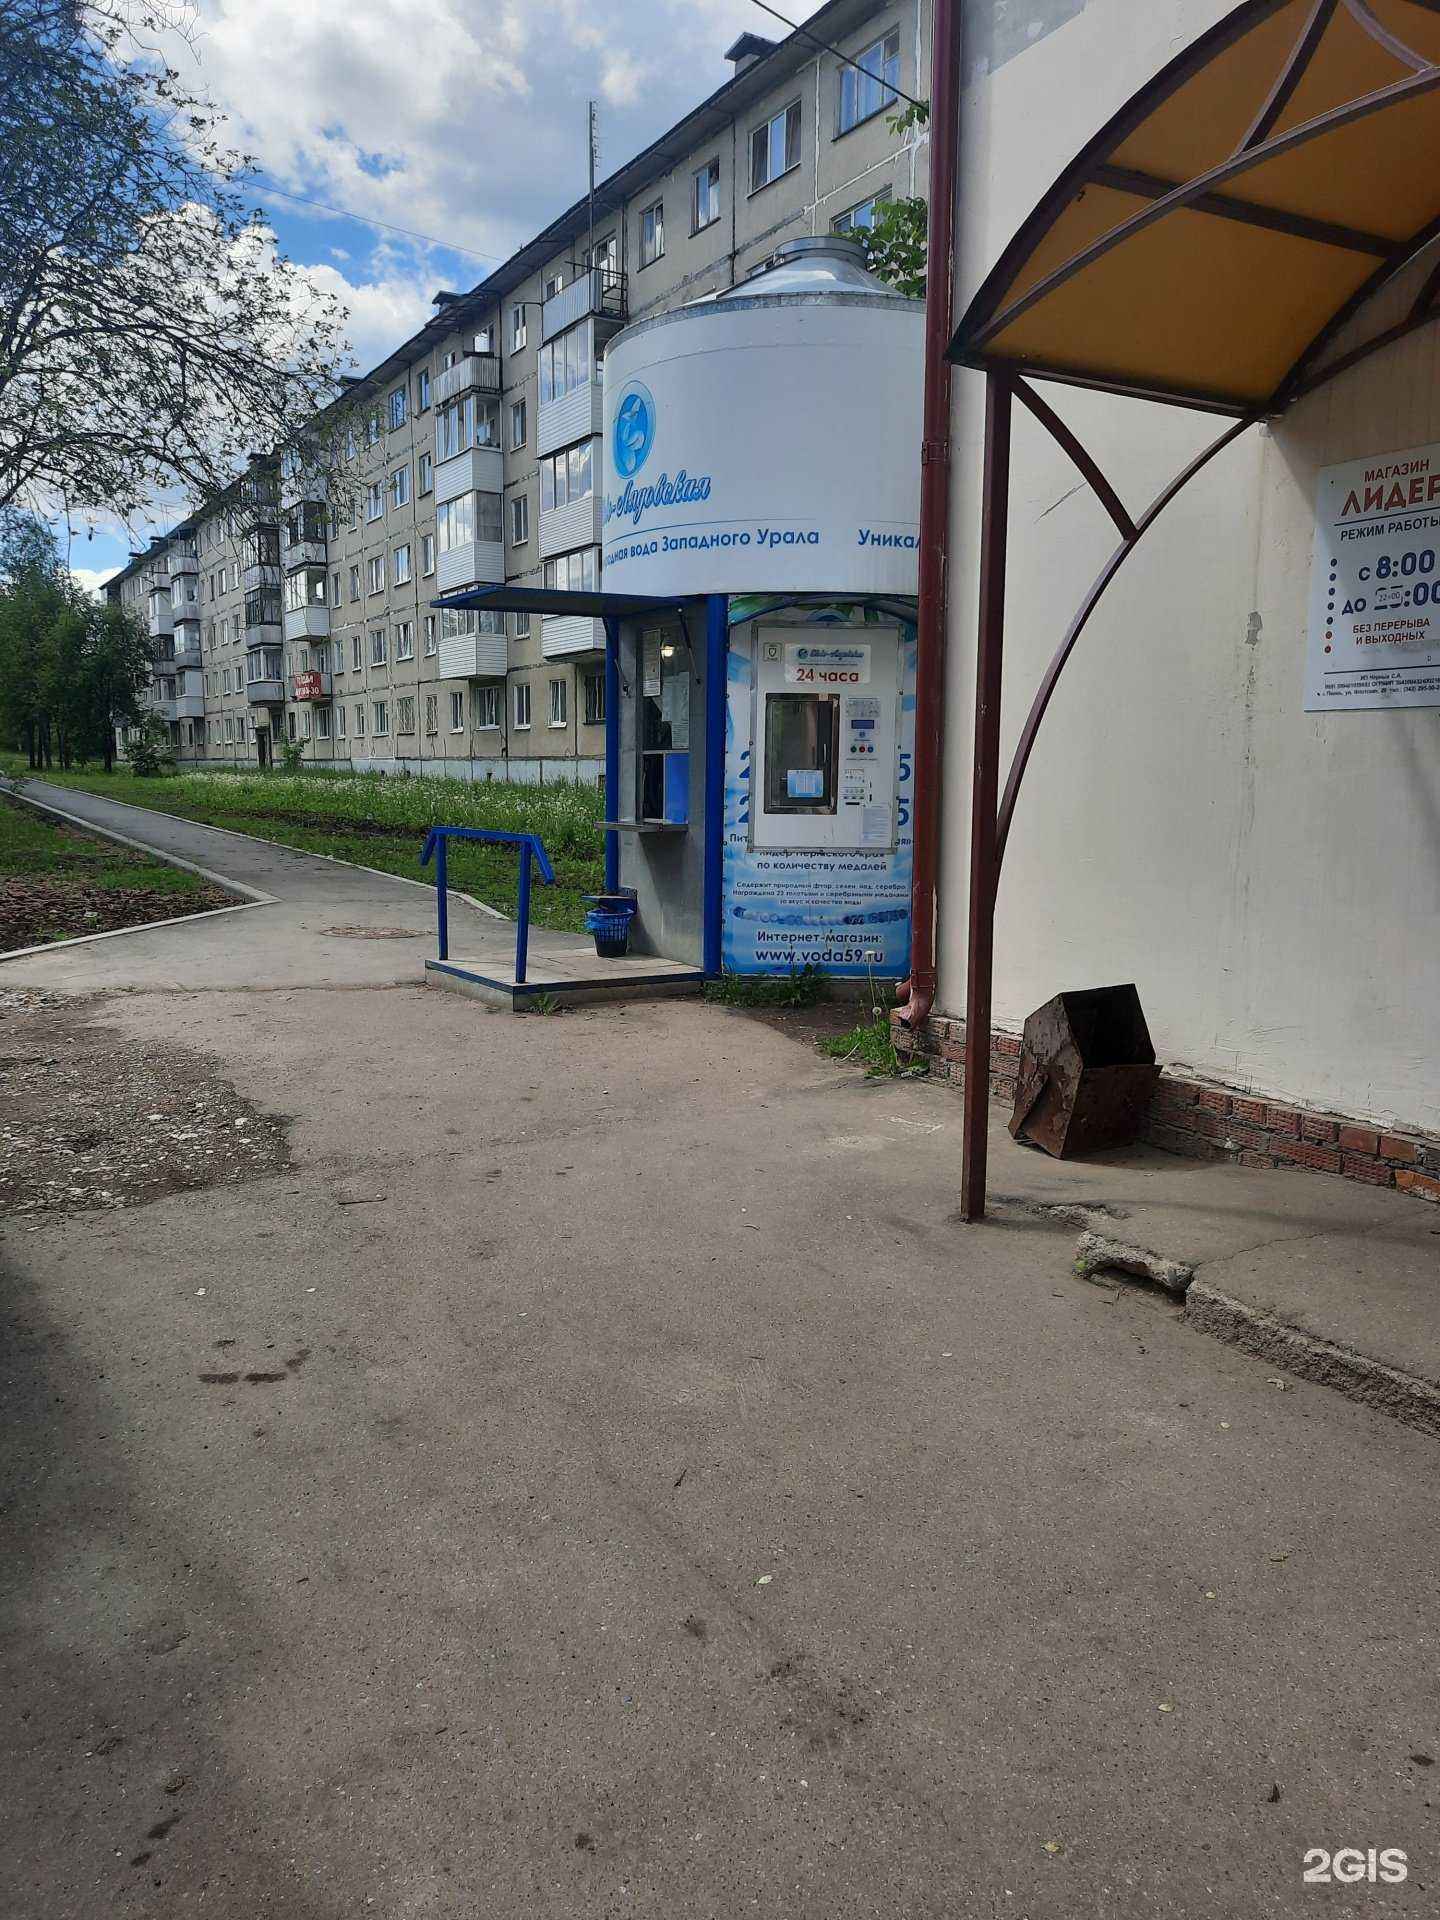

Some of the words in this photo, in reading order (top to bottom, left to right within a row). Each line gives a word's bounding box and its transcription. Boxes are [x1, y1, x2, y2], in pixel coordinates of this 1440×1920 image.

[1364, 458, 1430, 482] МАГАЗИН
[1341, 473, 1440, 516] ЛИДЕР
[1340, 524, 1385, 541] РЕЖИМ
[1387, 516, 1440, 534] РАБОТЫ
[630, 541, 658, 558] вода
[662, 532, 751, 552] Западного
[757, 528, 819, 548] Урала
[1376, 549, 1435, 579] 8:00
[1352, 623, 1371, 634] БЕЗ
[1374, 617, 1430, 632] ПЕРЕРЫВА
[1356, 635, 1363, 645] И
[1365, 630, 1425, 645] ВЫХОДНЫХ
[796, 668, 815, 682] 24
[818, 671, 859, 682] часа
[773, 862, 834, 871] количеству
[838, 862, 887, 871] медалей
[736, 882, 772, 890] Содержит
[757, 931, 882, 944] Интернет-магазин:
